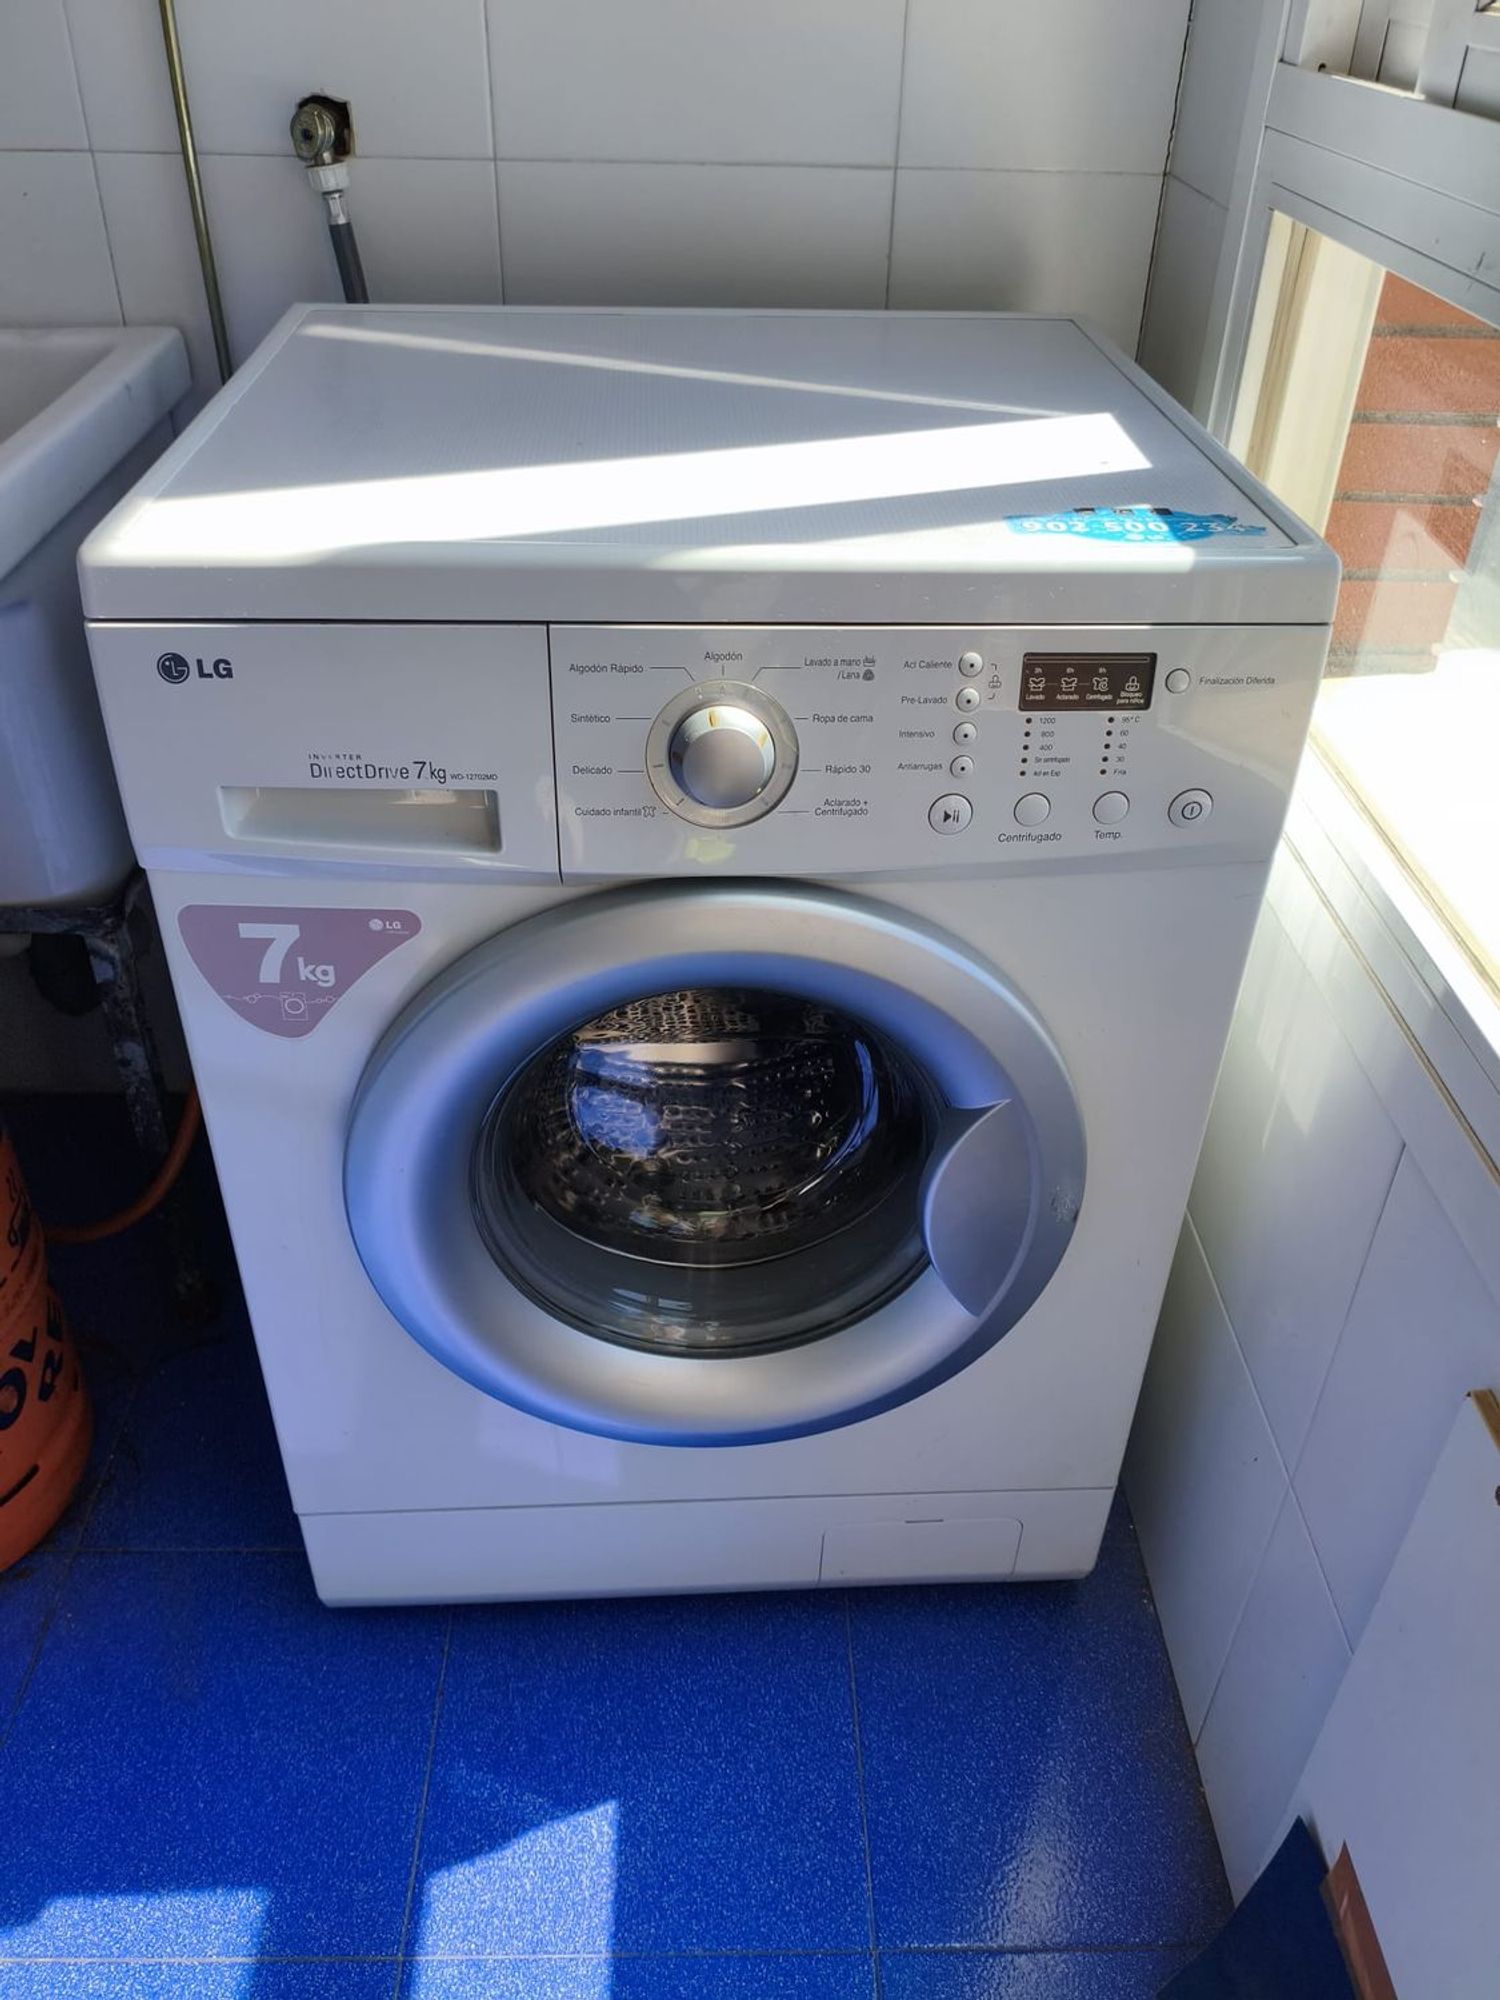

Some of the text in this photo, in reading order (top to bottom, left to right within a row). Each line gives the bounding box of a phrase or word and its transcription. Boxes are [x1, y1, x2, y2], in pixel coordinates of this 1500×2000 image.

[1104, 519, 1169, 533] 500
[704, 651, 743, 663] Algodón
[804, 657, 832, 668] Lavado
[840, 658, 862, 668] mano
[196, 658, 234, 679] LG
[569, 662, 644, 677] Algodón Rápido
[918, 660, 953, 671] Caliente
[570, 712, 611, 725] Sintético
[812, 713, 874, 725] Ropa de cama
[1039, 716, 1056, 724] 1200
[898, 730, 935, 740] Intensivo
[572, 764, 613, 776] Delicado
[825, 764, 871, 775] Rápido 30
[897, 762, 943, 772] Antiarrugas
[823, 797, 861, 807] Aclarado
[574, 806, 642, 817] Cuidado infantil
[814, 807, 869, 818] Centrifugado
[997, 831, 1063, 844] Centrifugado
